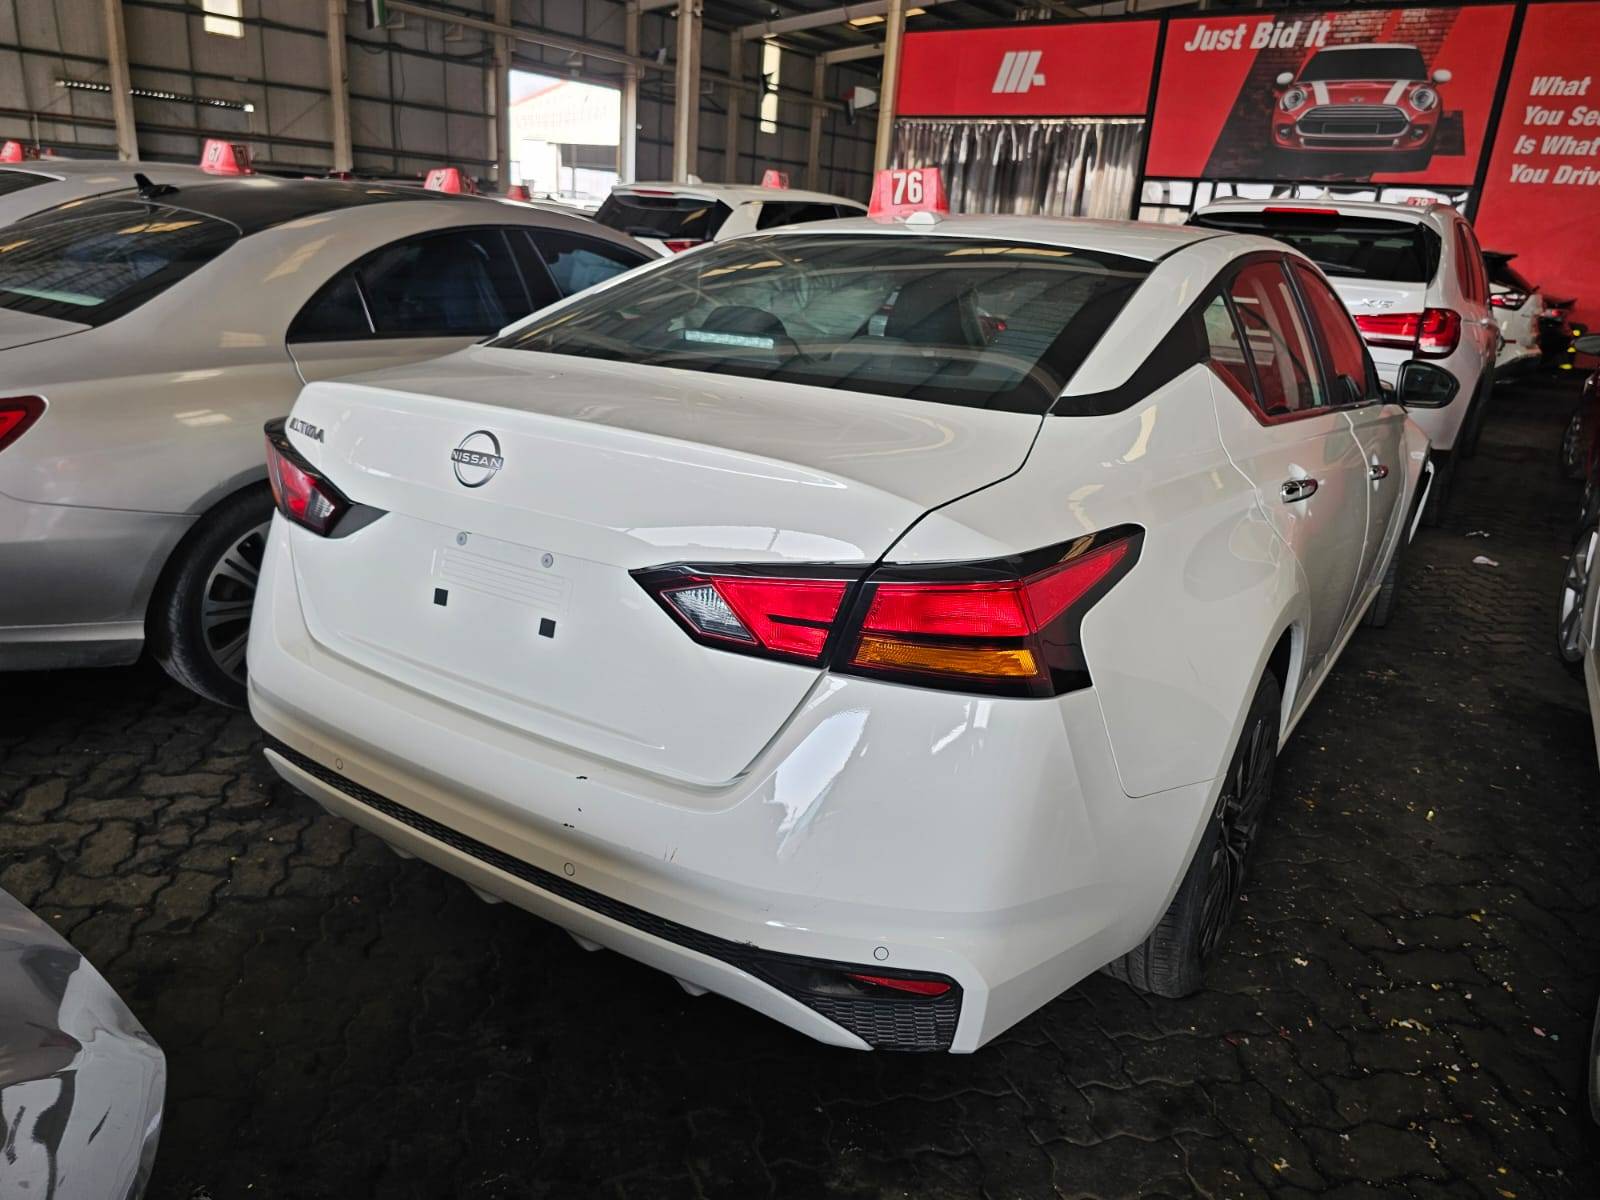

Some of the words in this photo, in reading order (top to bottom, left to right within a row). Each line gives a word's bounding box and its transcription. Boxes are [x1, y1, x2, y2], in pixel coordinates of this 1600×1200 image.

[1184, 24, 1247, 52] Just
[1250, 21, 1301, 49] Bid
[1304, 20, 1331, 48] It
[1529, 76, 1592, 96] What
[1523, 106, 1565, 126] You
[1568, 105, 1600, 126] Se
[1512, 134, 1537, 155] Is
[1540, 135, 1600, 156] What
[1509, 163, 1550, 184] You
[1552, 165, 1600, 186] Driv
[893, 171, 923, 205] 76
[453, 450, 502, 468] NISSAN
